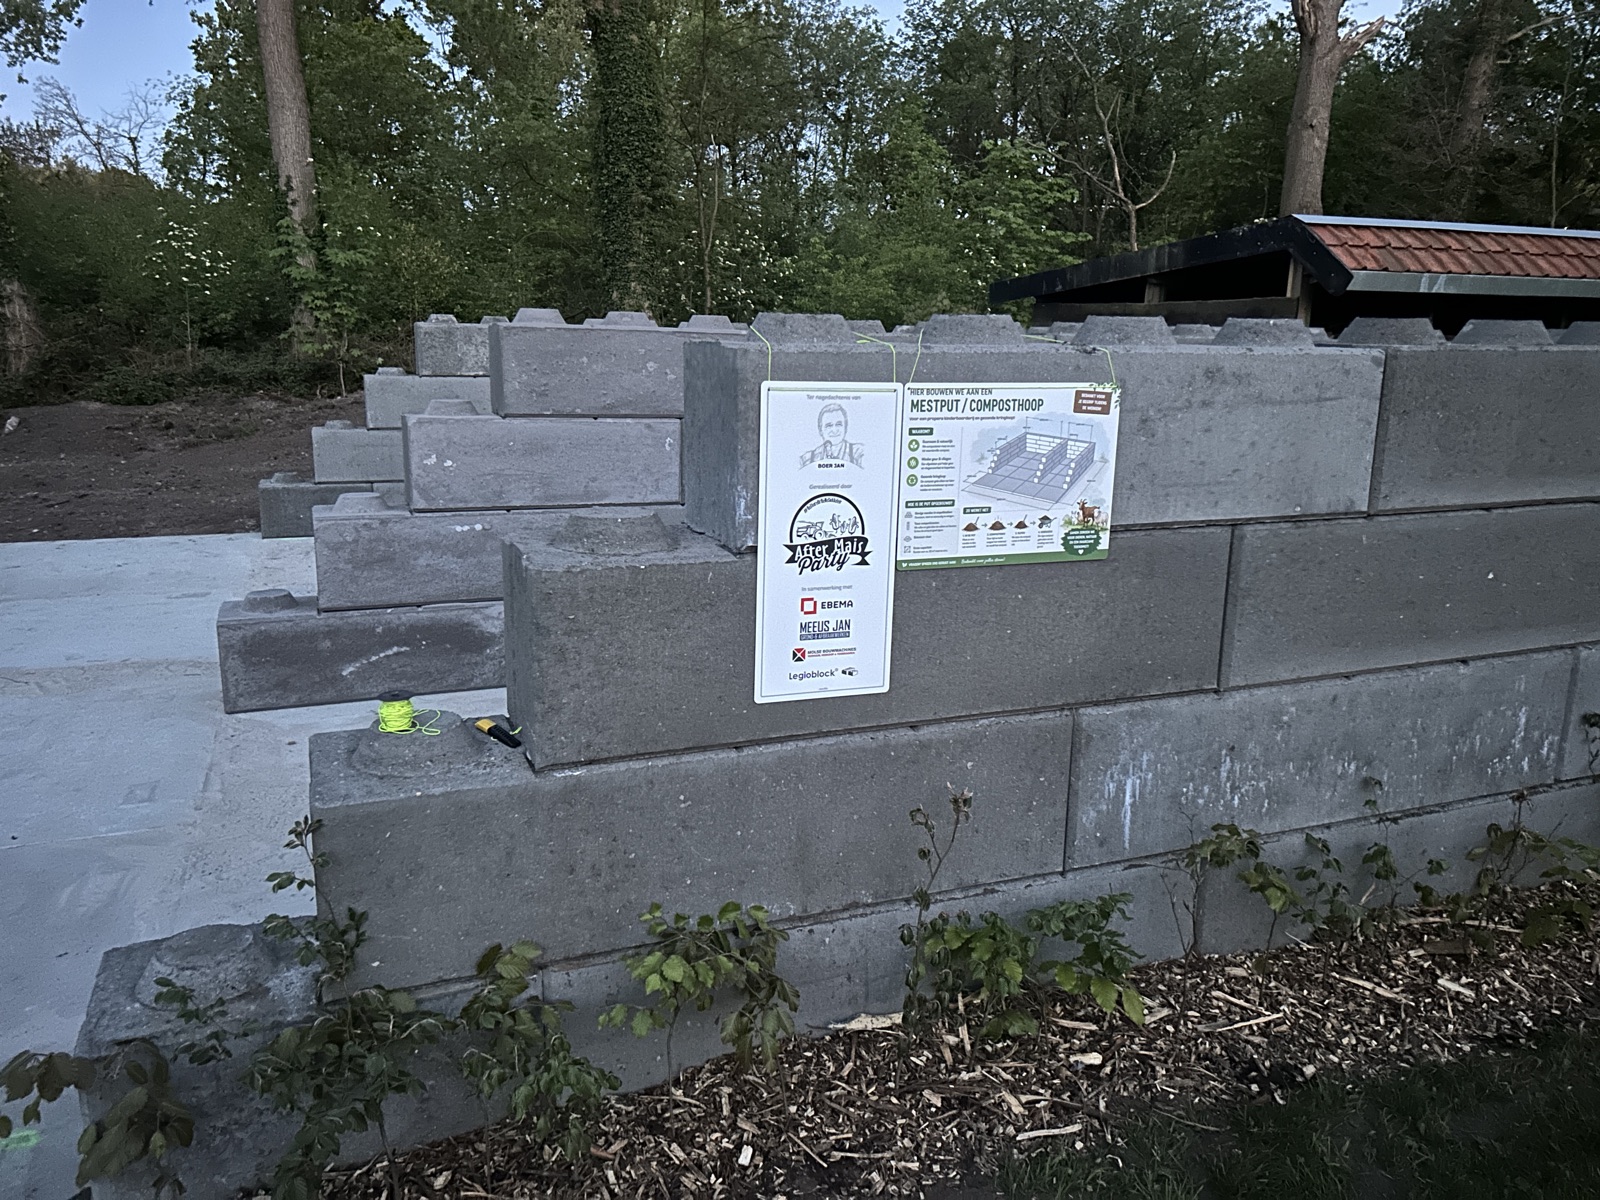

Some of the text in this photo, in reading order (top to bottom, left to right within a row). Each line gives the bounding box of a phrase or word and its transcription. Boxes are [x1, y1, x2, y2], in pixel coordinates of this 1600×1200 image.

[910, 398, 1044, 413] MESTPUT / COMPOSTHOOP
[795, 538, 863, 561] After Mais
[798, 552, 850, 575] Party
[821, 600, 853, 609] EBEMA
[800, 619, 851, 633] MEEUS JAN
